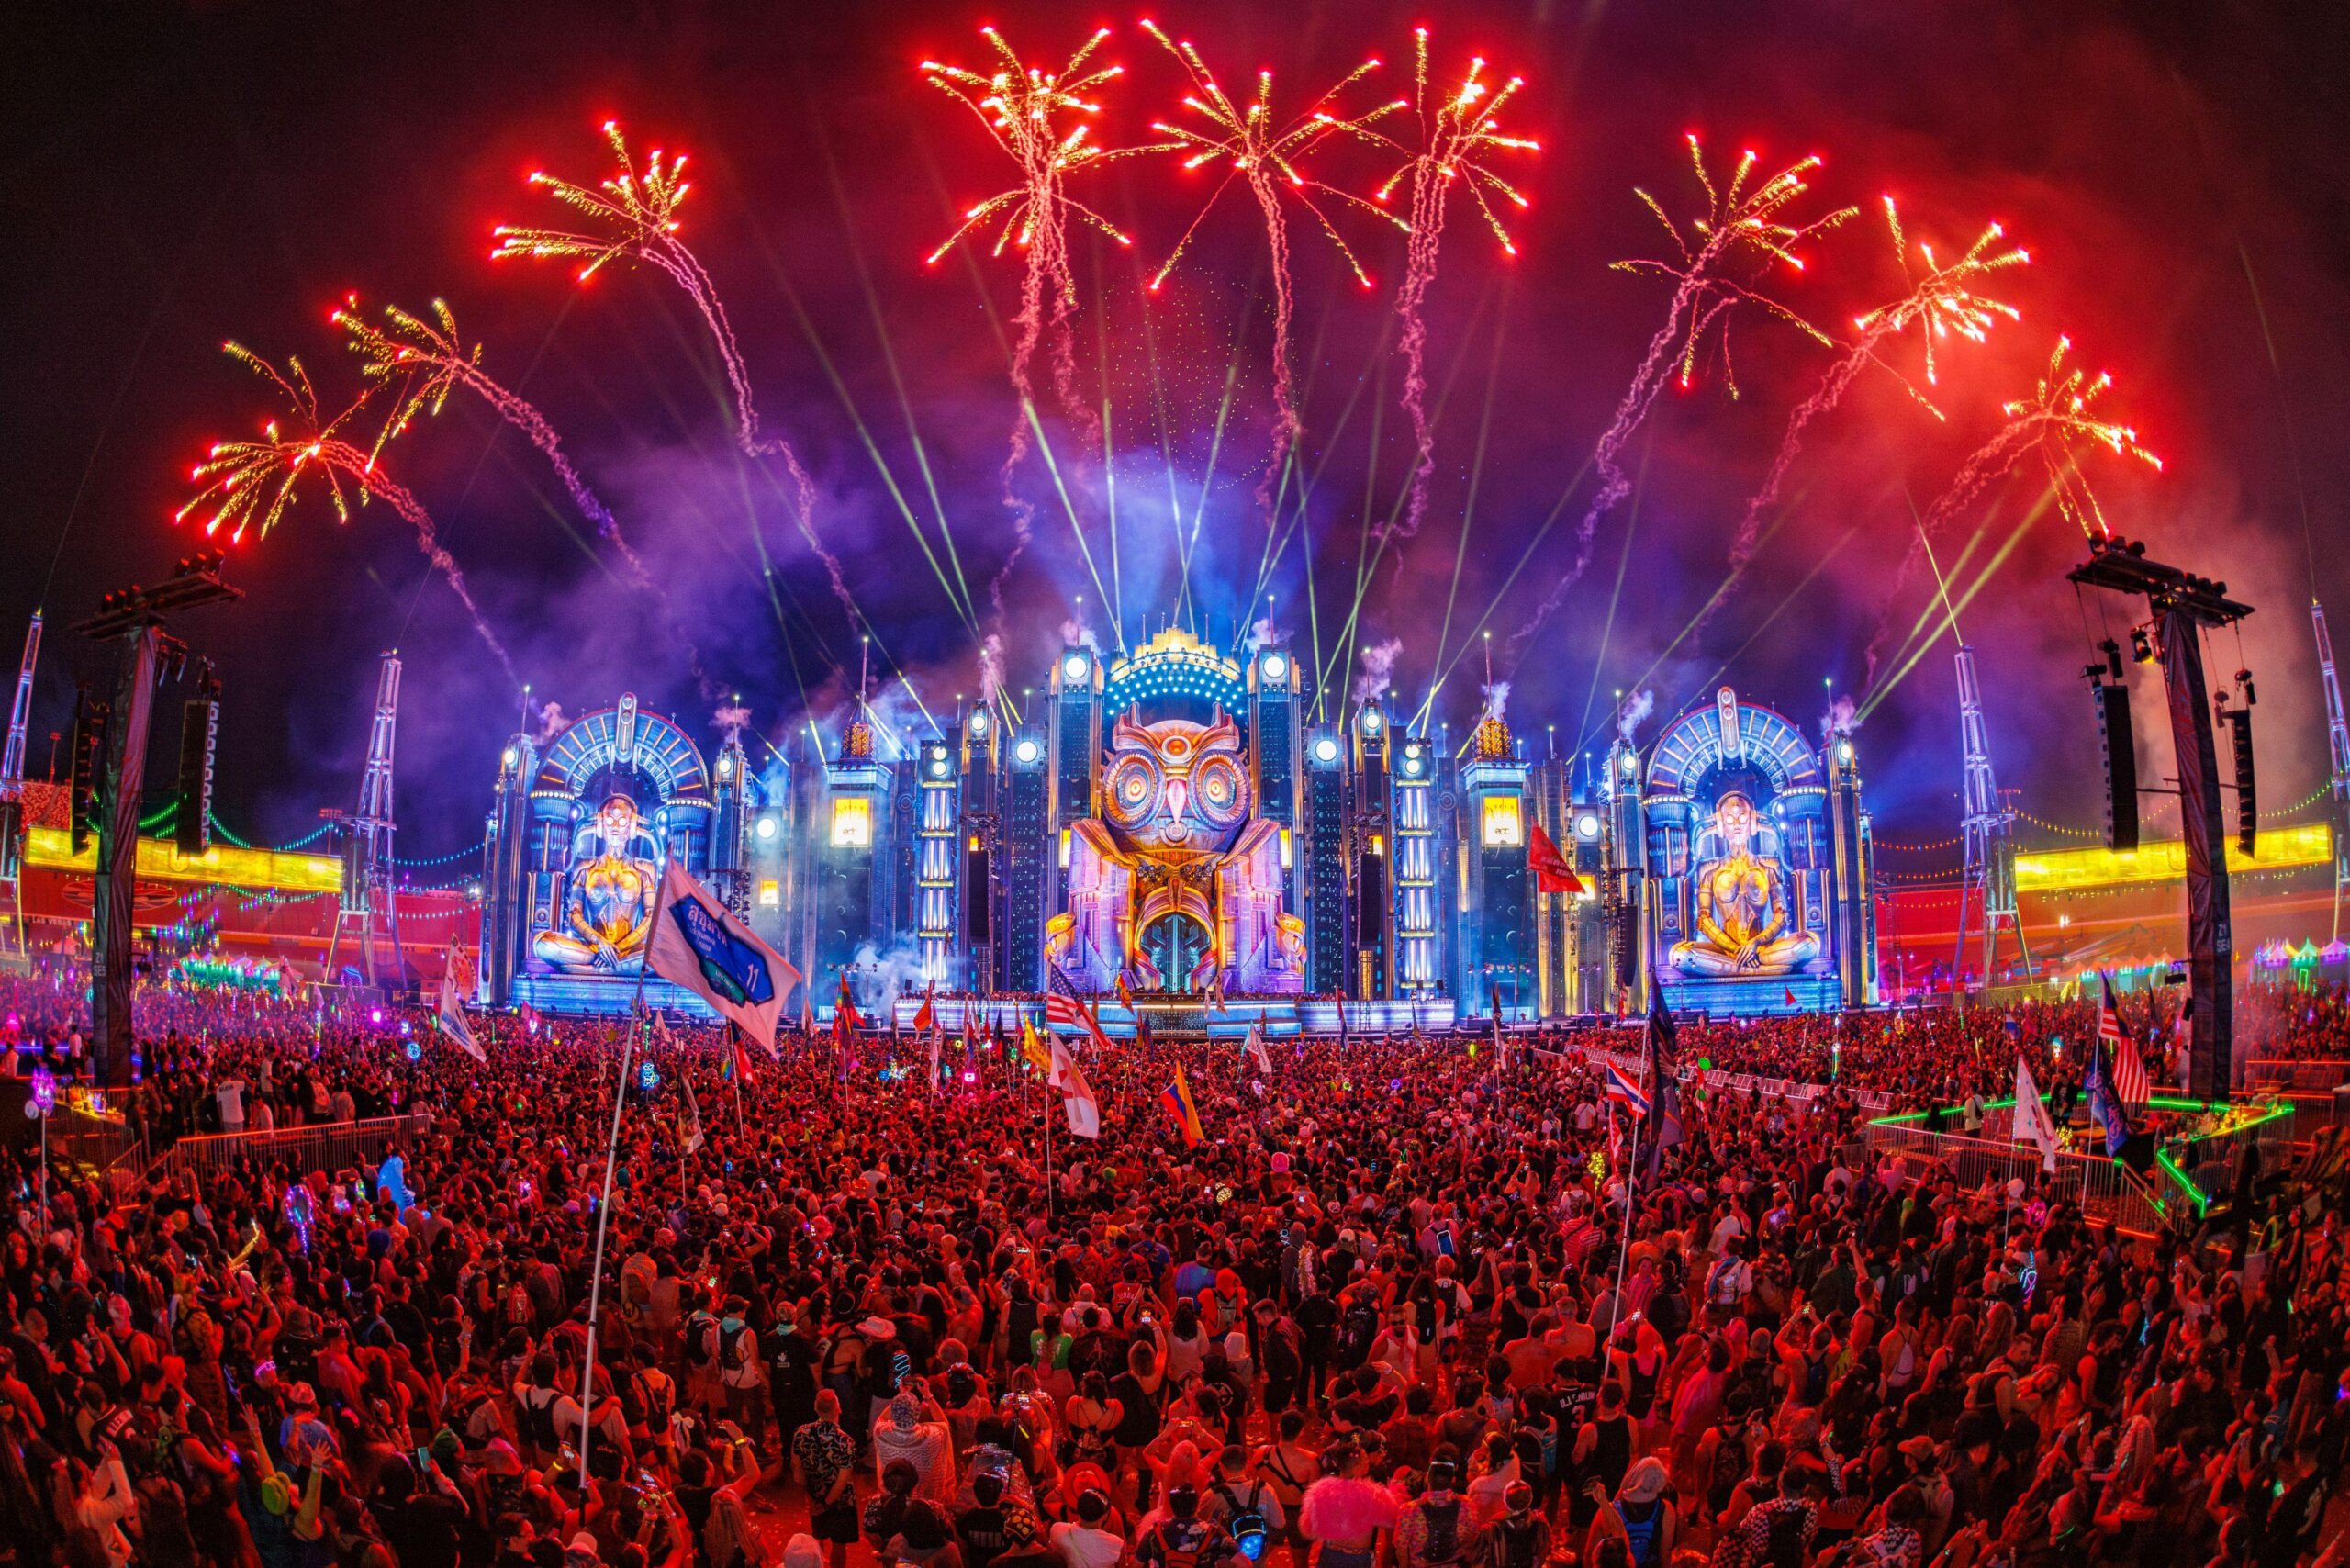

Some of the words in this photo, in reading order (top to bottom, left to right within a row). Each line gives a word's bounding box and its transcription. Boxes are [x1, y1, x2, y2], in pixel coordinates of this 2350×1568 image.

[32, 915, 46, 924] LAS
[48, 918, 73, 926] VEGAS
[747, 963, 760, 992] 11
